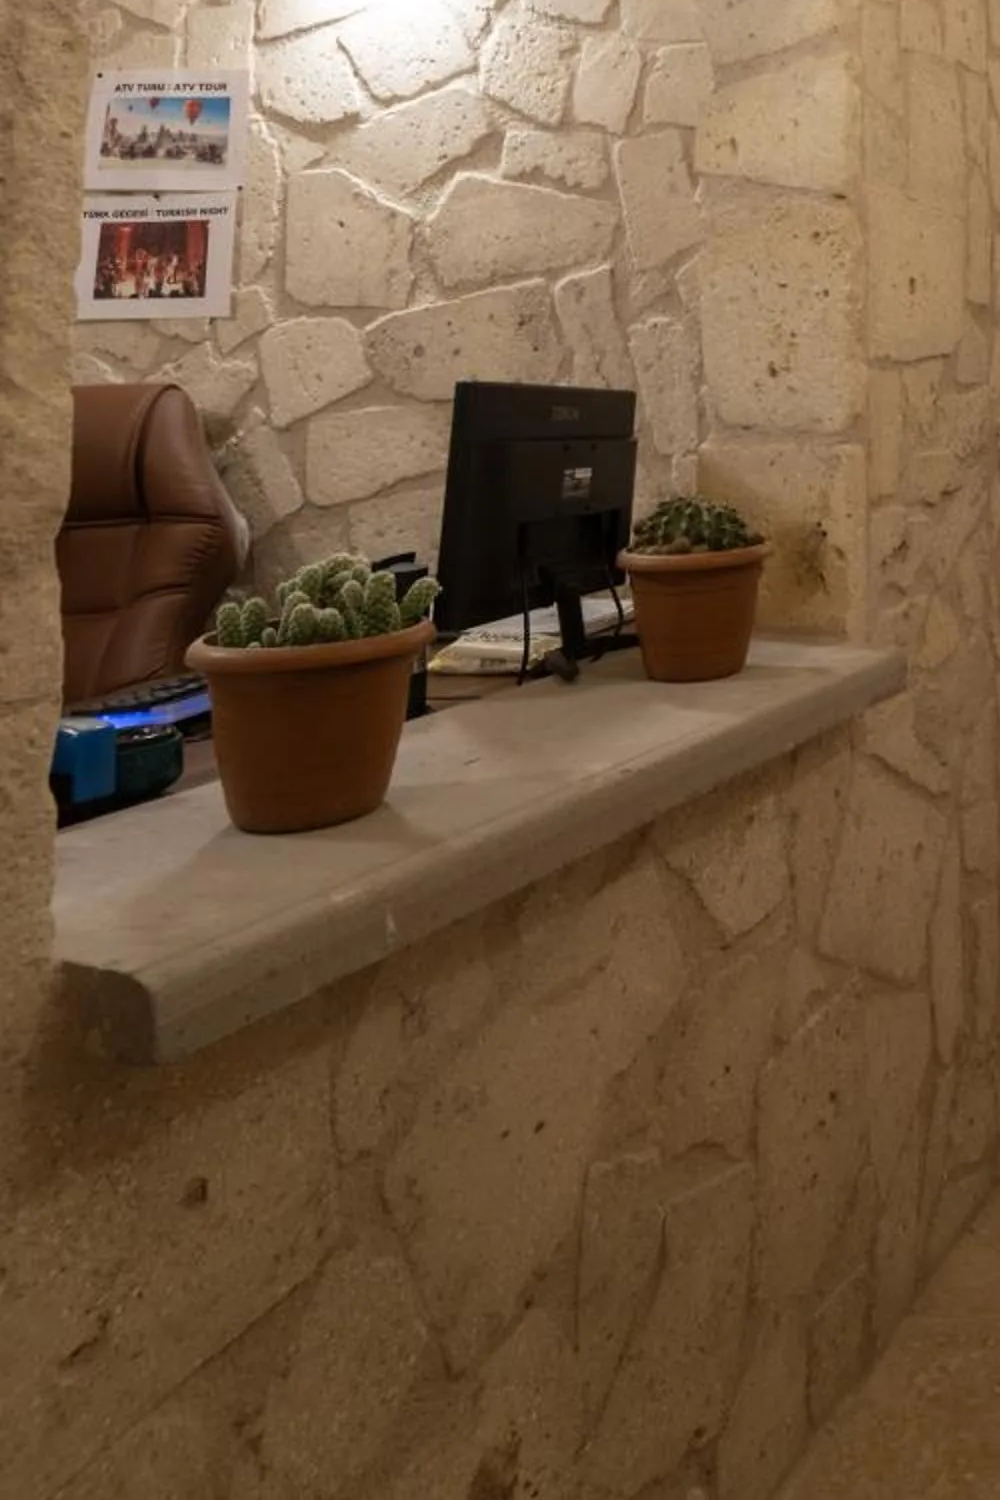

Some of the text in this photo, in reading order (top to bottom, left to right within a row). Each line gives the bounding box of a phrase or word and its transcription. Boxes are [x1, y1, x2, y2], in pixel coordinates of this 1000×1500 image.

[114, 84, 135, 92] ATV
[173, 83, 195, 92] ATV
[198, 83, 227, 92] TOUR
